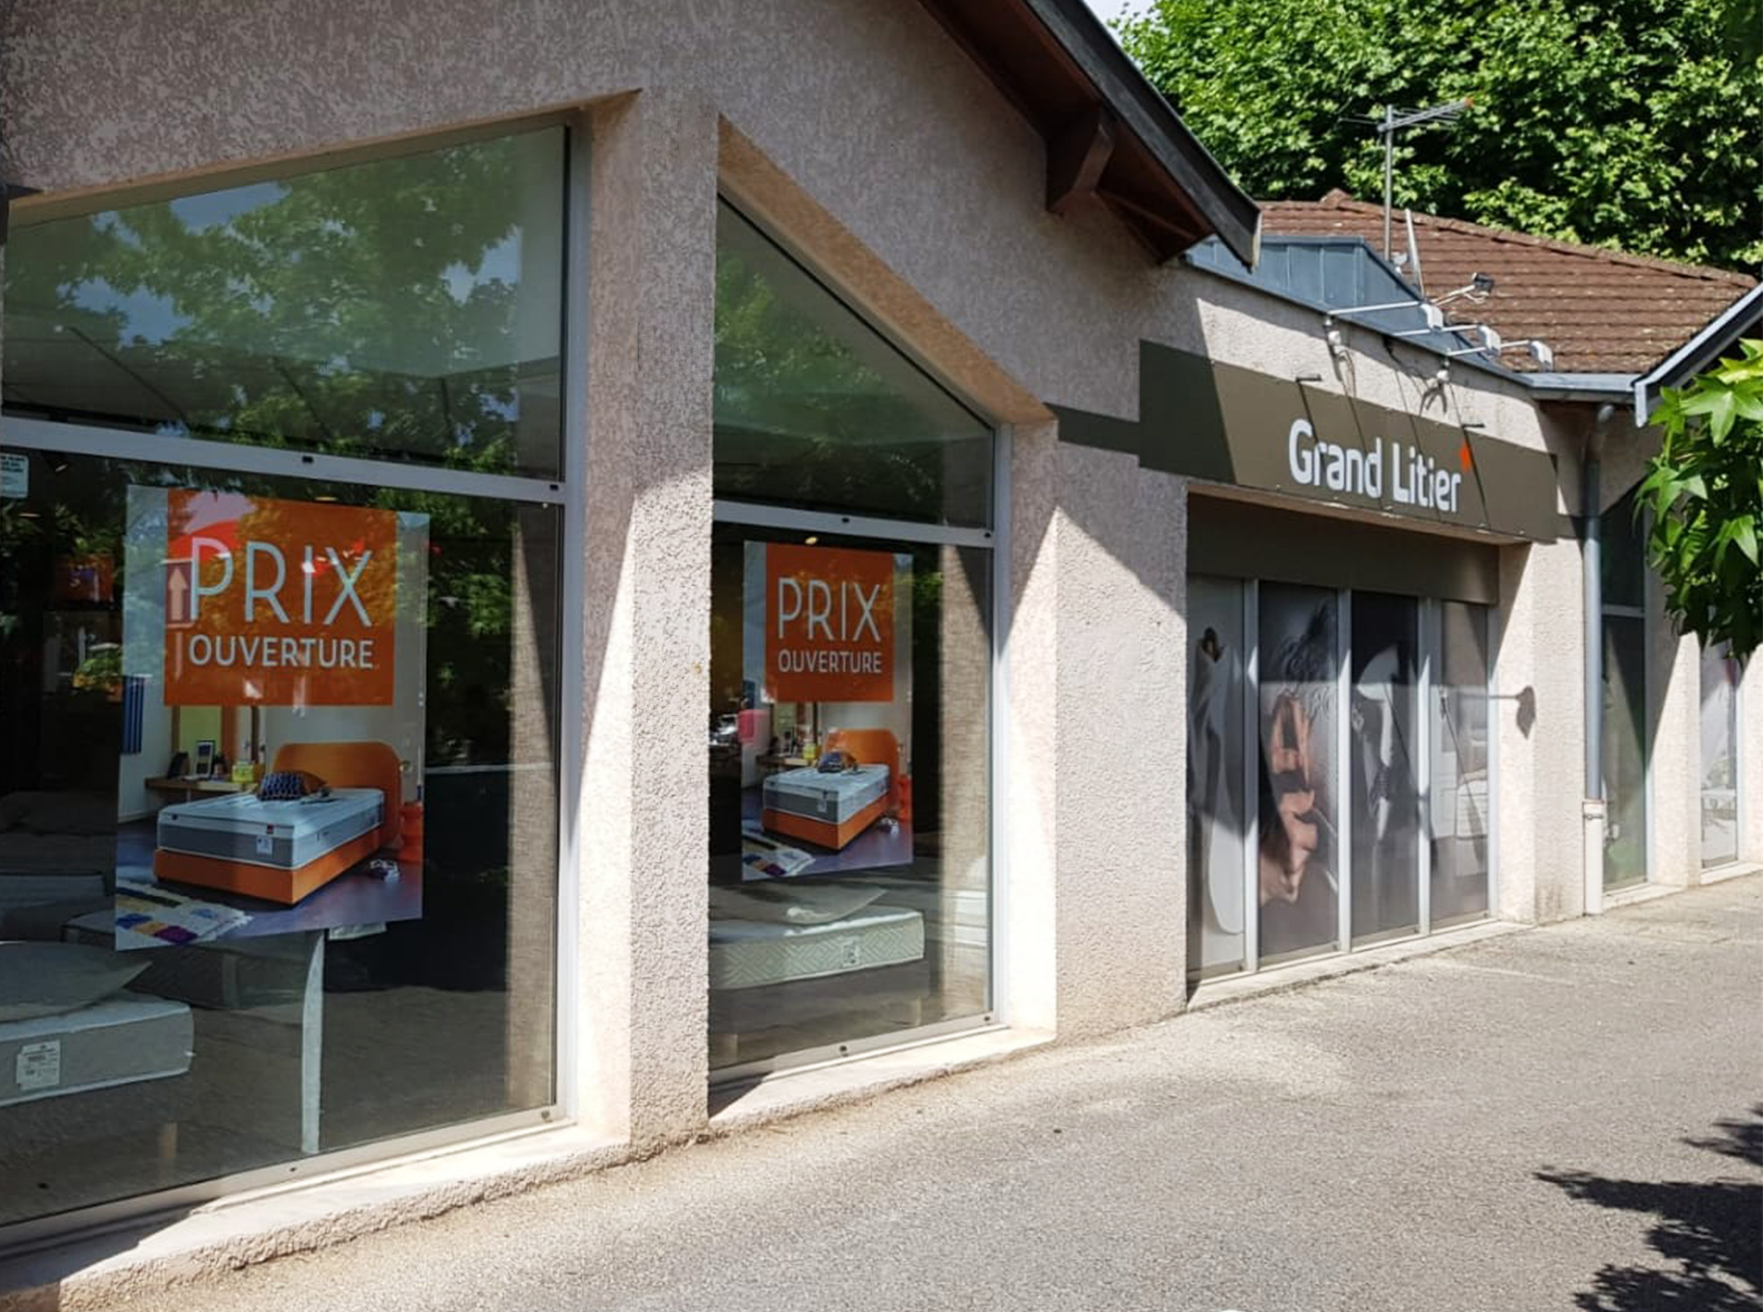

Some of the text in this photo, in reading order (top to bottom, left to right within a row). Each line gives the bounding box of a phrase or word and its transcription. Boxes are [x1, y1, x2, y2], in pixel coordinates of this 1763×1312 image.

[1289, 418, 1461, 512] Grand Litier
[190, 536, 372, 627] PRIX
[778, 577, 881, 642] PRIX
[189, 634, 373, 669] OUVERTURE
[778, 649, 882, 673] OUVERTURE
